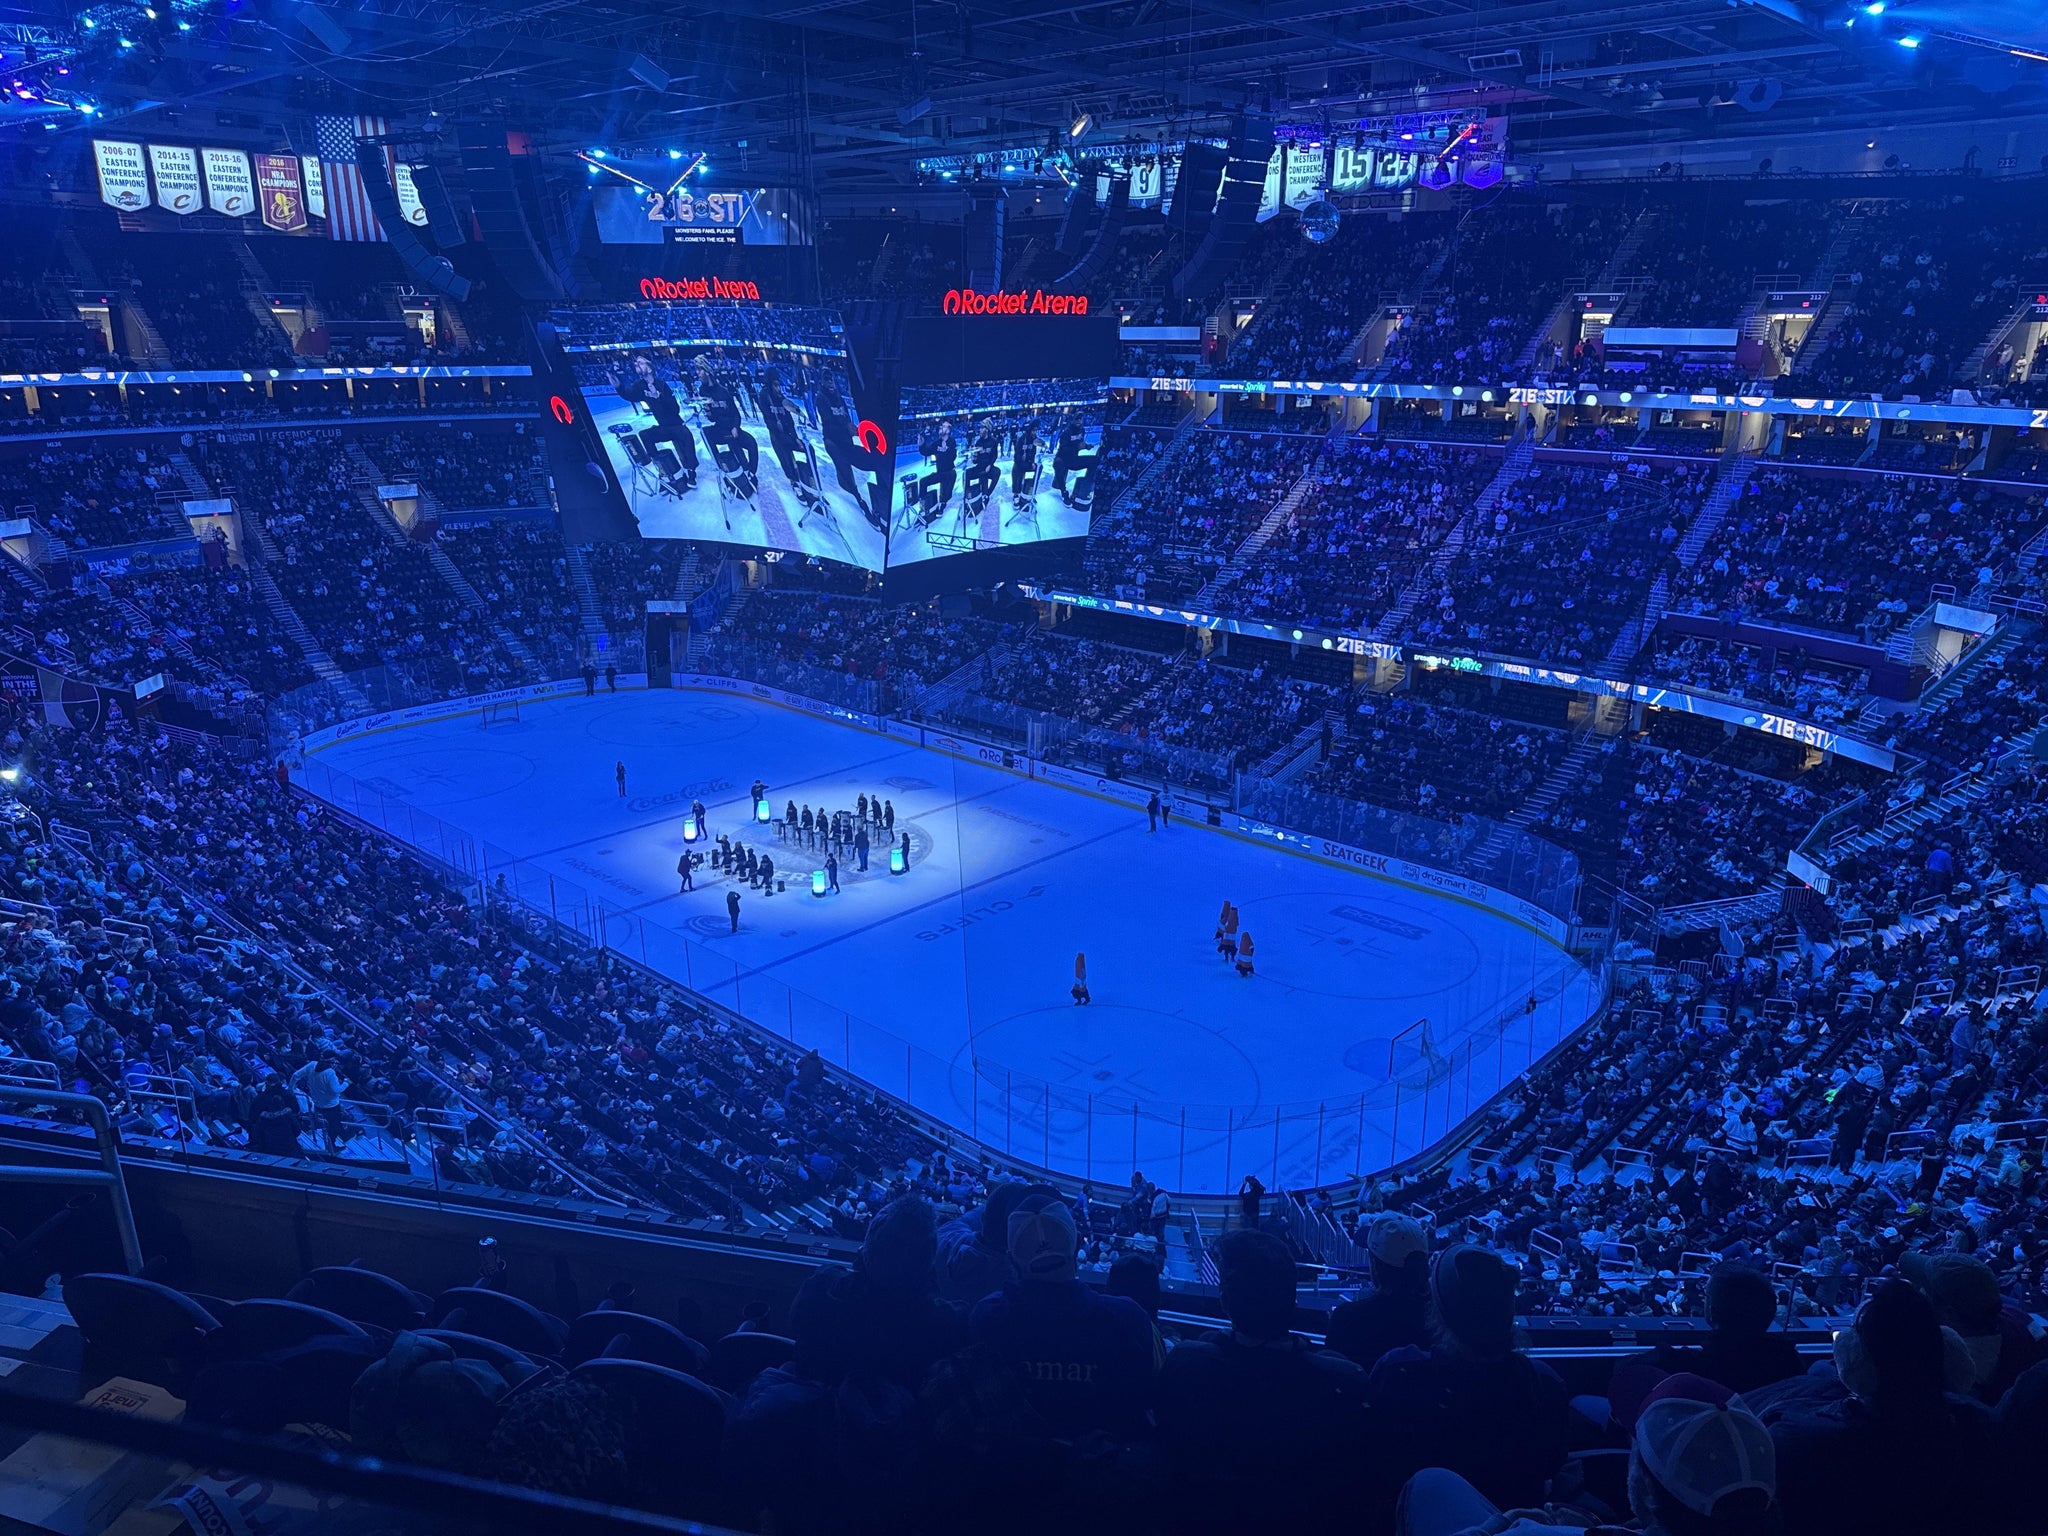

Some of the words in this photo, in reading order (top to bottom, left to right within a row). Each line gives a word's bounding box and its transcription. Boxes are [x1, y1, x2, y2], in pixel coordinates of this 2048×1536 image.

[102, 145, 137, 157] 2006-07
[157, 150, 190, 161] 2014-15
[105, 158, 138, 168] EASTERN
[209, 153, 242, 164] 2015-16
[268, 158, 285, 167] 2016
[1293, 154, 1321, 164] WESTERN
[1339, 149, 1368, 179] 15
[101, 167, 146, 178] CONFERENCE
[160, 162, 191, 172] EASTERN
[213, 164, 242, 174] EASTERN
[1288, 164, 1325, 175] CONFERENCE
[156, 171, 198, 182] CONFERENCE
[209, 174, 249, 185] CONFERENCE
[271, 170, 286, 180] NBA
[105, 177, 146, 188] CHAMPIONS
[160, 181, 198, 191] CHAMPIONS
[261, 178, 298, 189] CHAMPIONS
[1139, 168, 1150, 194] 9
[211, 183, 249, 194] CHAMPIONS
[653, 277, 713, 300] Rocket
[713, 276, 760, 300] Arena
[961, 290, 1029, 315] Rocket
[1029, 290, 1088, 315] Arena
[1151, 378, 1171, 390] 216
[1244, 381, 1266, 393] Sprite
[1509, 388, 1538, 403] 216
[1544, 389, 1576, 405] STIX
[315, 428, 342, 438] CLUB
[1077, 595, 1098, 607] Sprite
[1337, 636, 1365, 655] 216
[1372, 642, 1403, 662] STIX
[1450, 657, 1482, 671] Sprite
[2, 681, 14, 689] IN
[14, 680, 38, 689] THE
[706, 678, 738, 689] CLIFFS
[474, 695, 490, 704] HITS
[490, 689, 517, 701] HAPPEN
[1760, 713, 1797, 740] 216
[1803, 724, 1839, 754] STIX
[987, 751, 1023, 770] Roet
[1322, 841, 1389, 875] SEATGEEK
[1421, 870, 1444, 886] drug
[1443, 878, 1466, 892] mart
[914, 900, 1015, 942] CLIFFS
